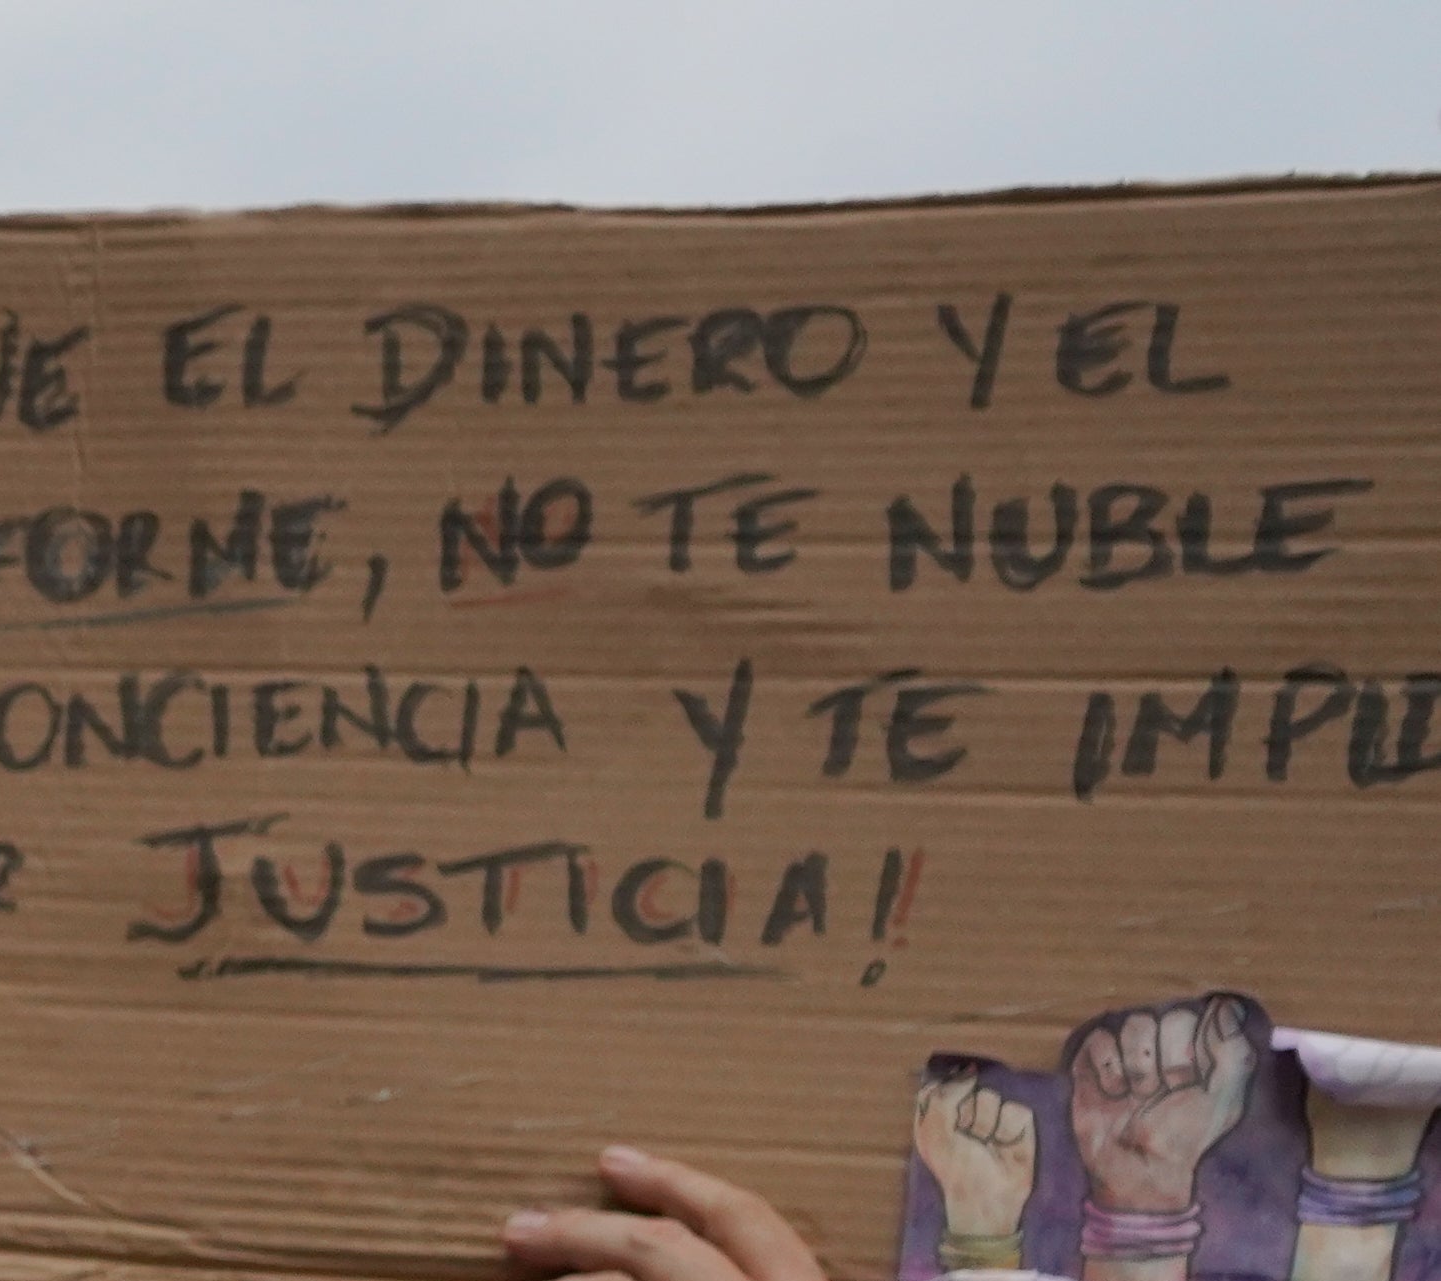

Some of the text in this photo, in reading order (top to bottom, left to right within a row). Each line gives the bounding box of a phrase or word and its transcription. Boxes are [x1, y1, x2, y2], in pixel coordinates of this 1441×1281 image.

[162, 304, 305, 408] EL
[353, 304, 867, 432] DINERO
[939, 292, 1013, 408] Y
[1057, 300, 1231, 394] EL
[439, 474, 593, 592] NO
[633, 472, 823, 574] TE
[885, 474, 1375, 592] NUBLE
[675, 656, 755, 820] Y
[807, 666, 999, 784] TE
